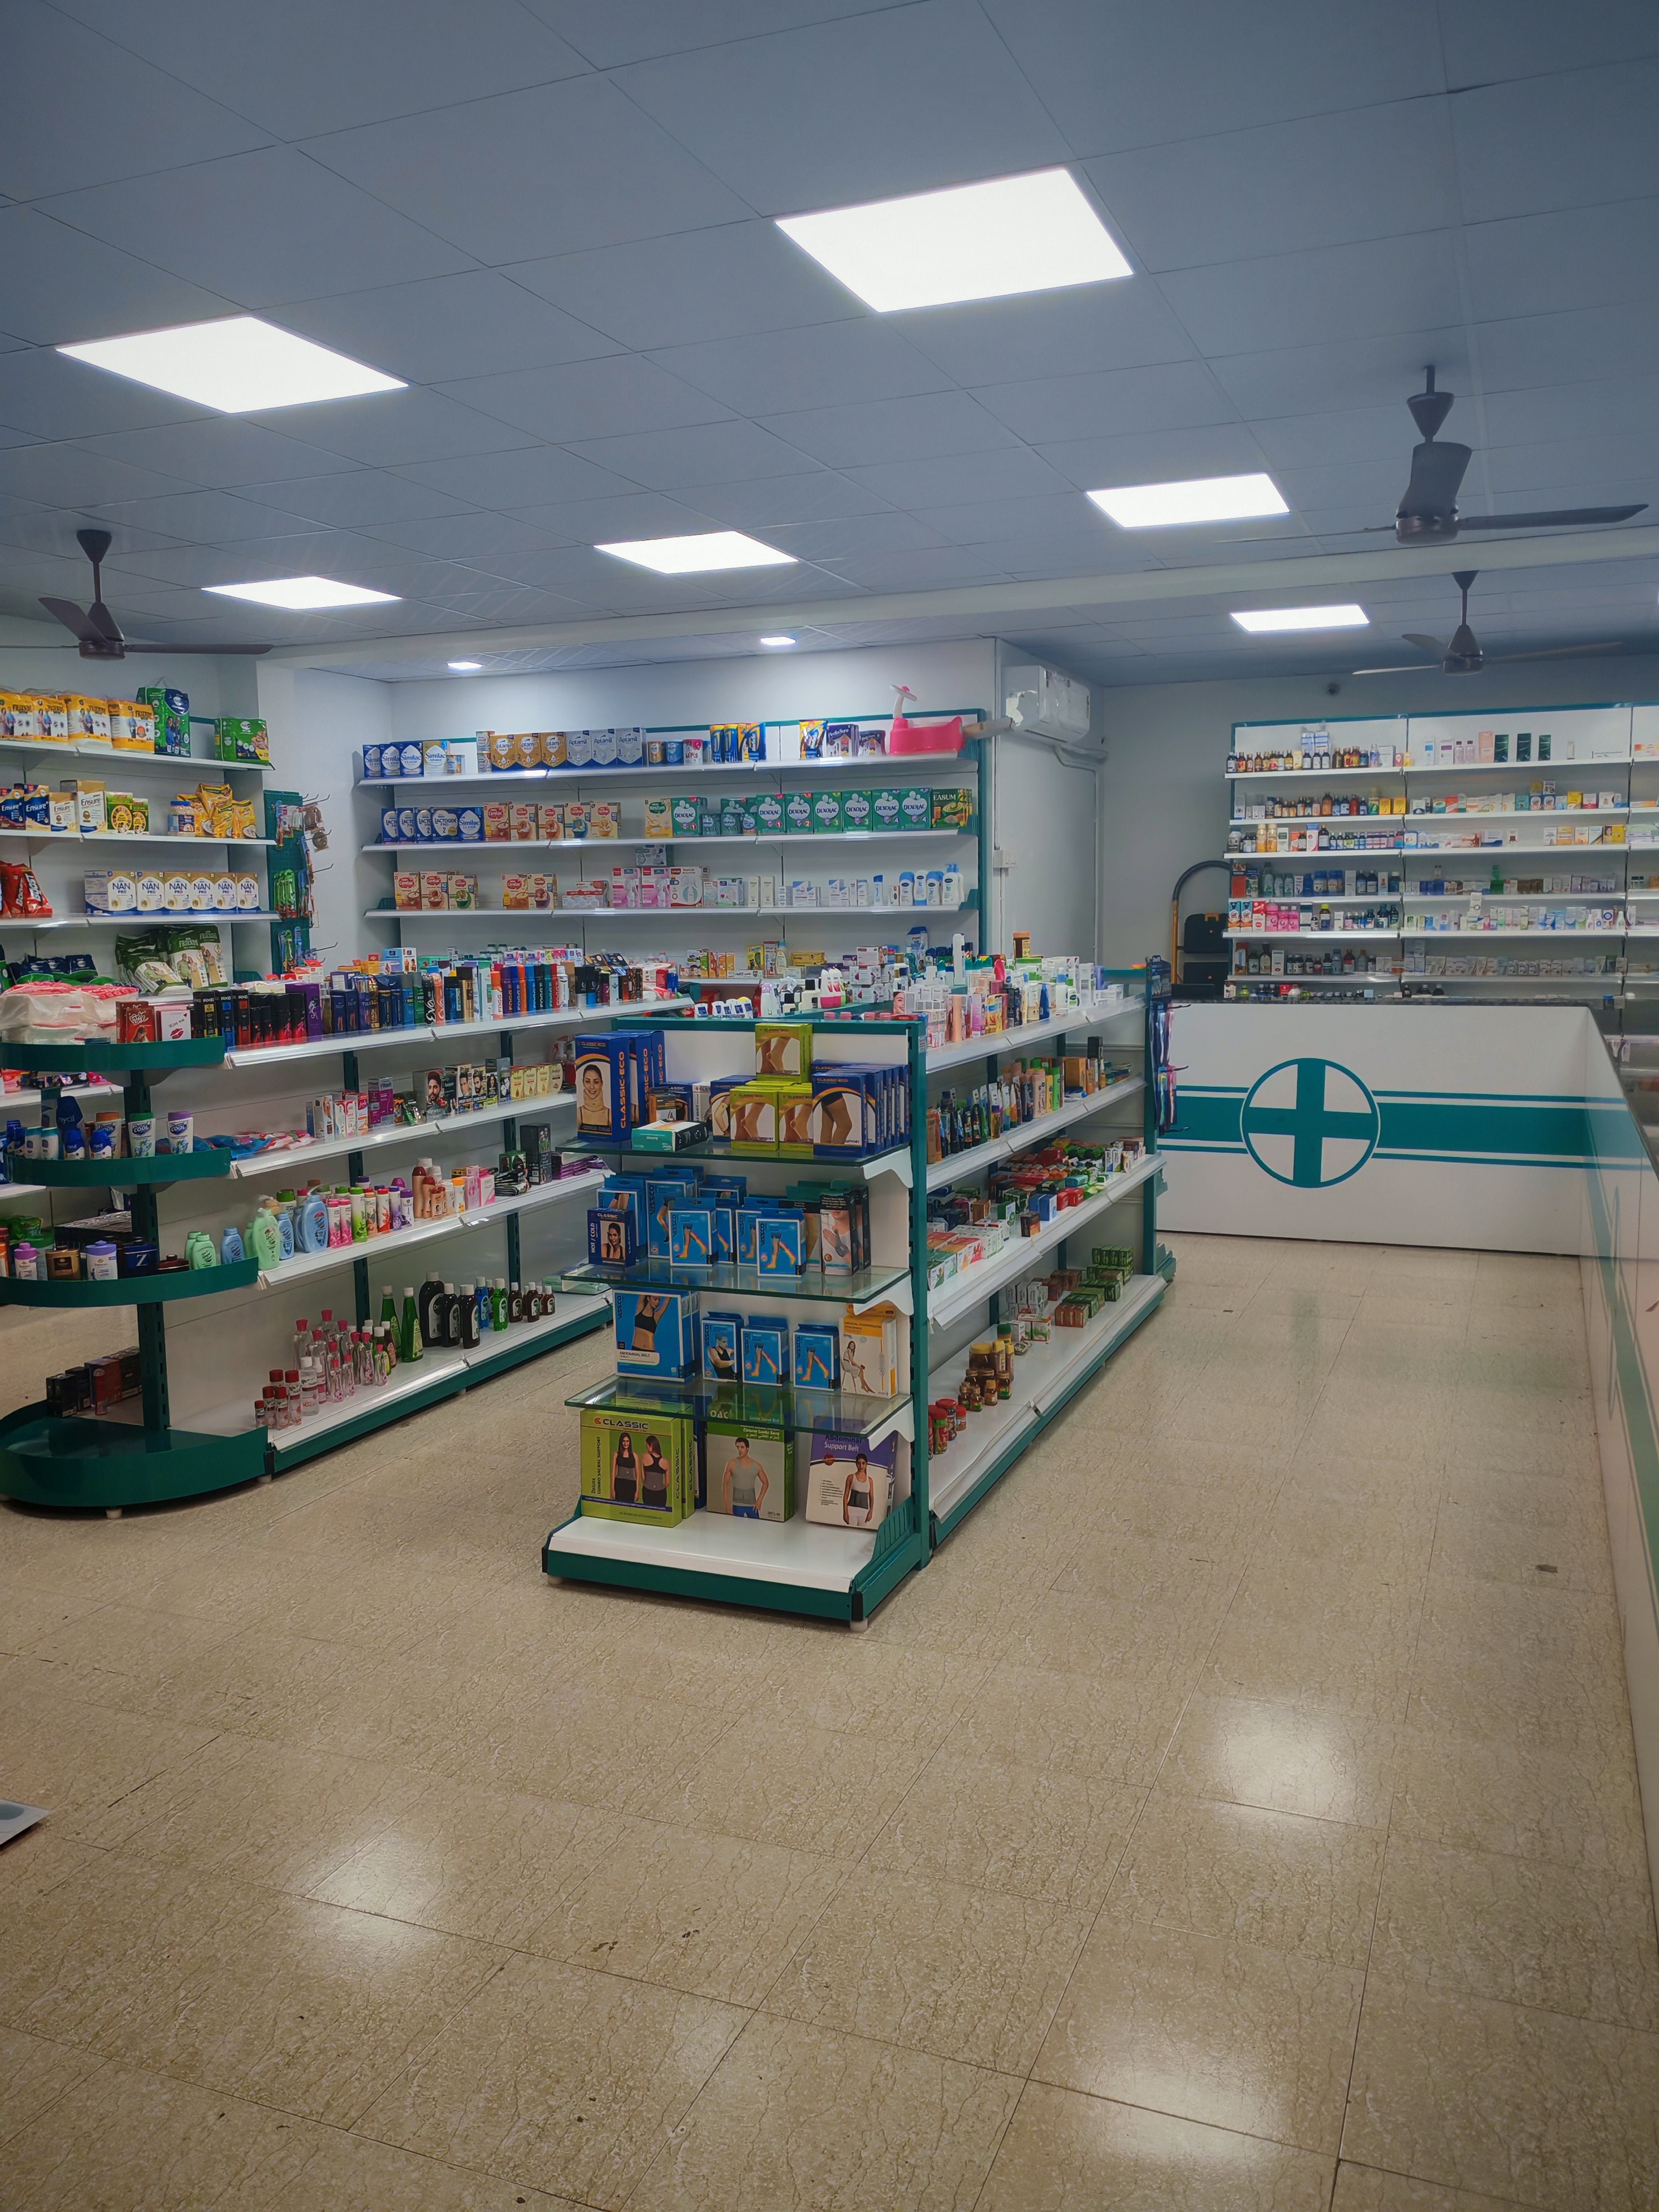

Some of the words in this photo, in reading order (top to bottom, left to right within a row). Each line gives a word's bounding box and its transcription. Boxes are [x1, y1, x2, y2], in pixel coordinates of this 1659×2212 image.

[80, 798, 101, 806] Ensure
[26, 804, 47, 812] Ensure
[24, 873, 42, 902] BOOST
[178, 939, 199, 947] FRIENDS
[619, 1051, 627, 1129] CLASSIC-ECO
[133, 1125, 151, 1133] COOL
[136, 1253, 147, 1267] Z
[603, 1419, 649, 1429] CLASSIC
[825, 1435, 862, 1445] Abdominal
[824, 1441, 847, 1452] Support
[848, 1444, 860, 1453] Belt
